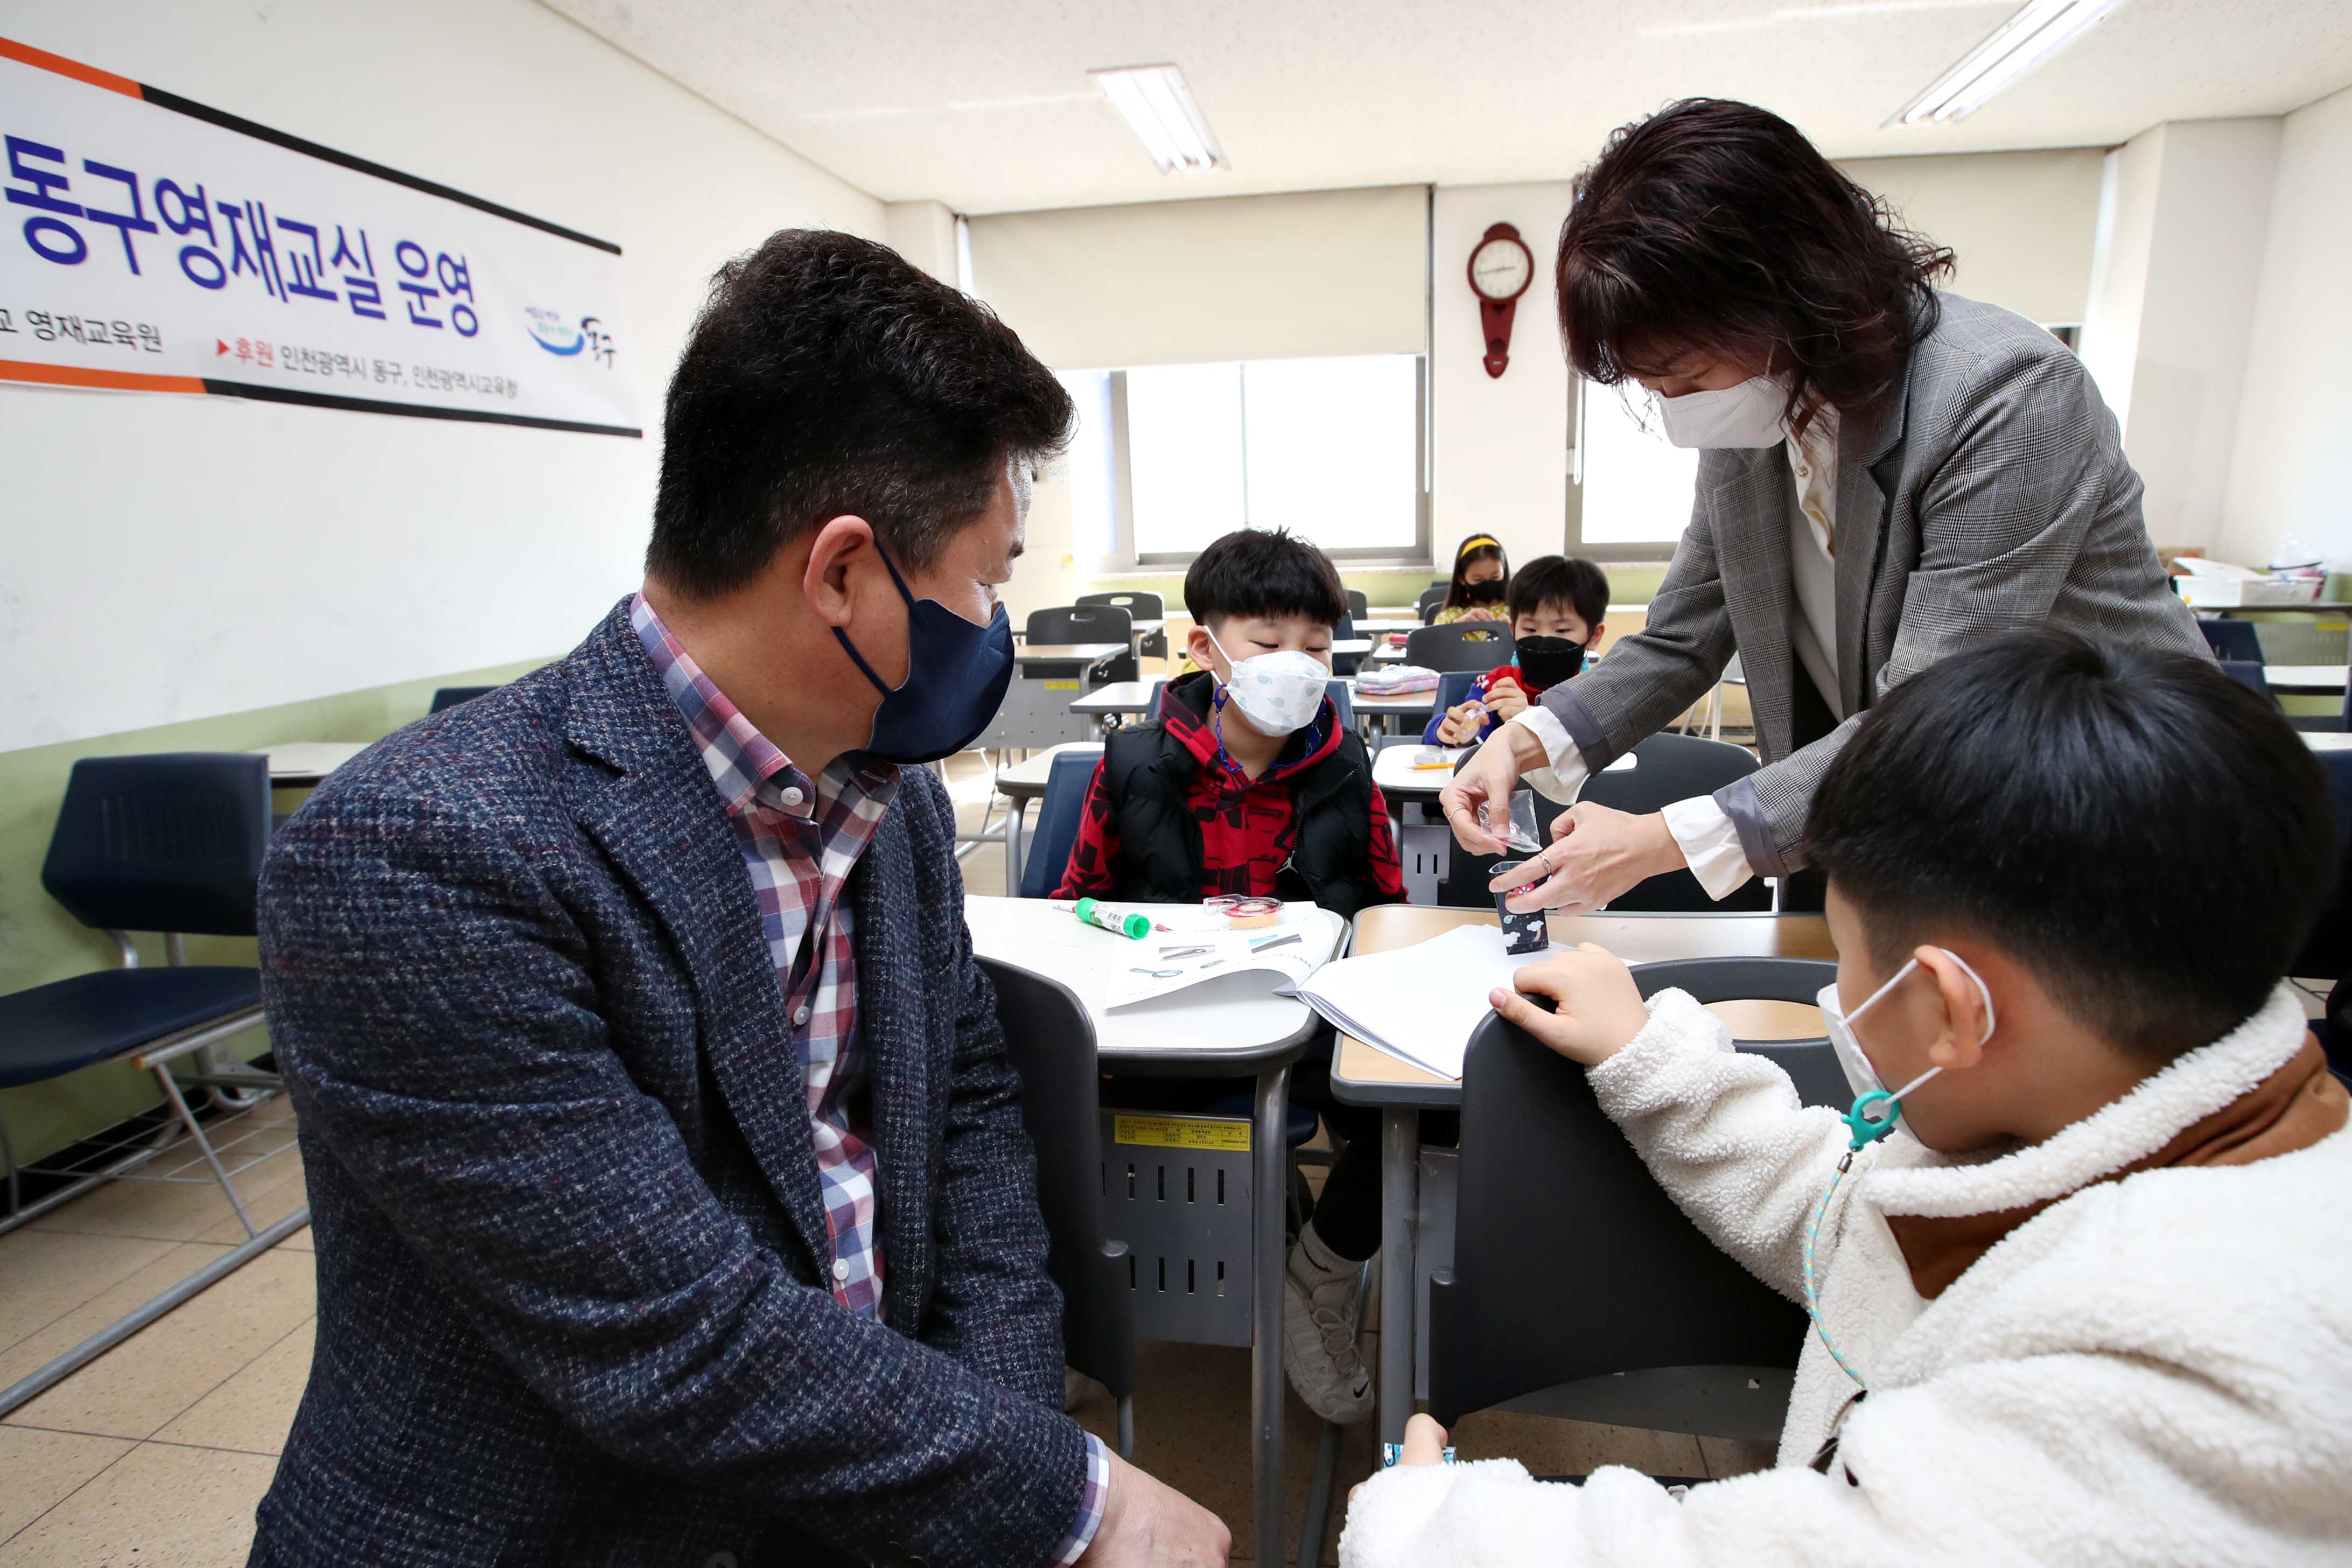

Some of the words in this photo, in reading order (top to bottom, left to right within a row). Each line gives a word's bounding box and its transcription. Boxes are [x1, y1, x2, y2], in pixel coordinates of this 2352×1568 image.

[3, 134, 387, 320] 동구영재교실
[395, 239, 480, 338] 운영
[26, 310, 163, 353] 영재교육원
[234, 337, 275, 367] 후원
[281, 345, 367, 380] 인천광역시
